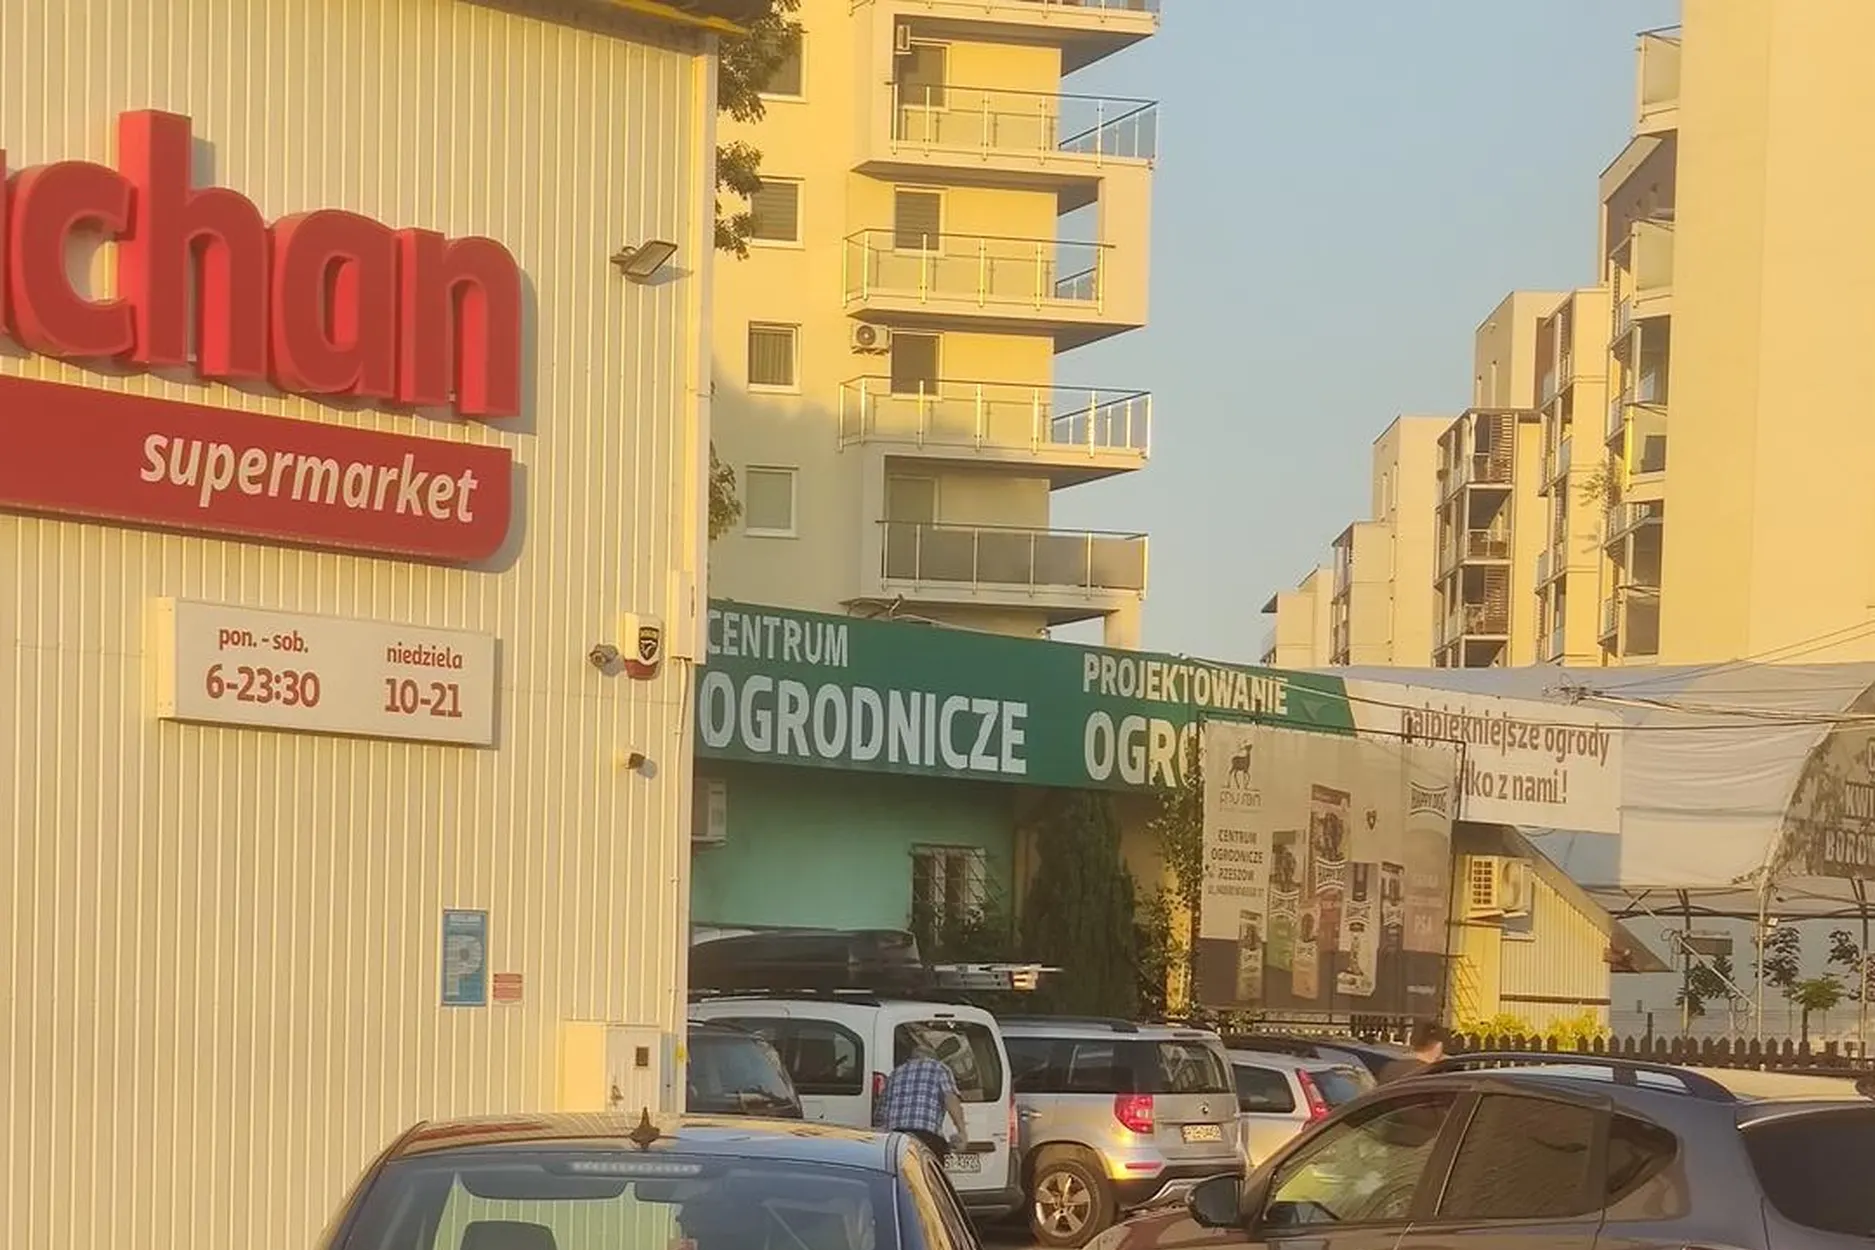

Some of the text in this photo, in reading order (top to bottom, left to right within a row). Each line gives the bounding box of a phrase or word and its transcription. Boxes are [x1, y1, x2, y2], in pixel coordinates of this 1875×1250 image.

[0, 109, 521, 417] chan
[140, 433, 479, 523] supermarket
[219, 627, 257, 651] pon.
[272, 632, 309, 653] sob.
[386, 642, 463, 670] niedziela
[707, 610, 849, 668] CENTRUM
[205, 663, 321, 708] 6-23:30
[384, 677, 463, 718] 10-21
[1083, 652, 1288, 716] PROJEKTOWANIE
[700, 671, 1028, 775] OGRODNICZE
[1544, 722, 1609, 767] ogrody
[1498, 773, 1508, 800] z
